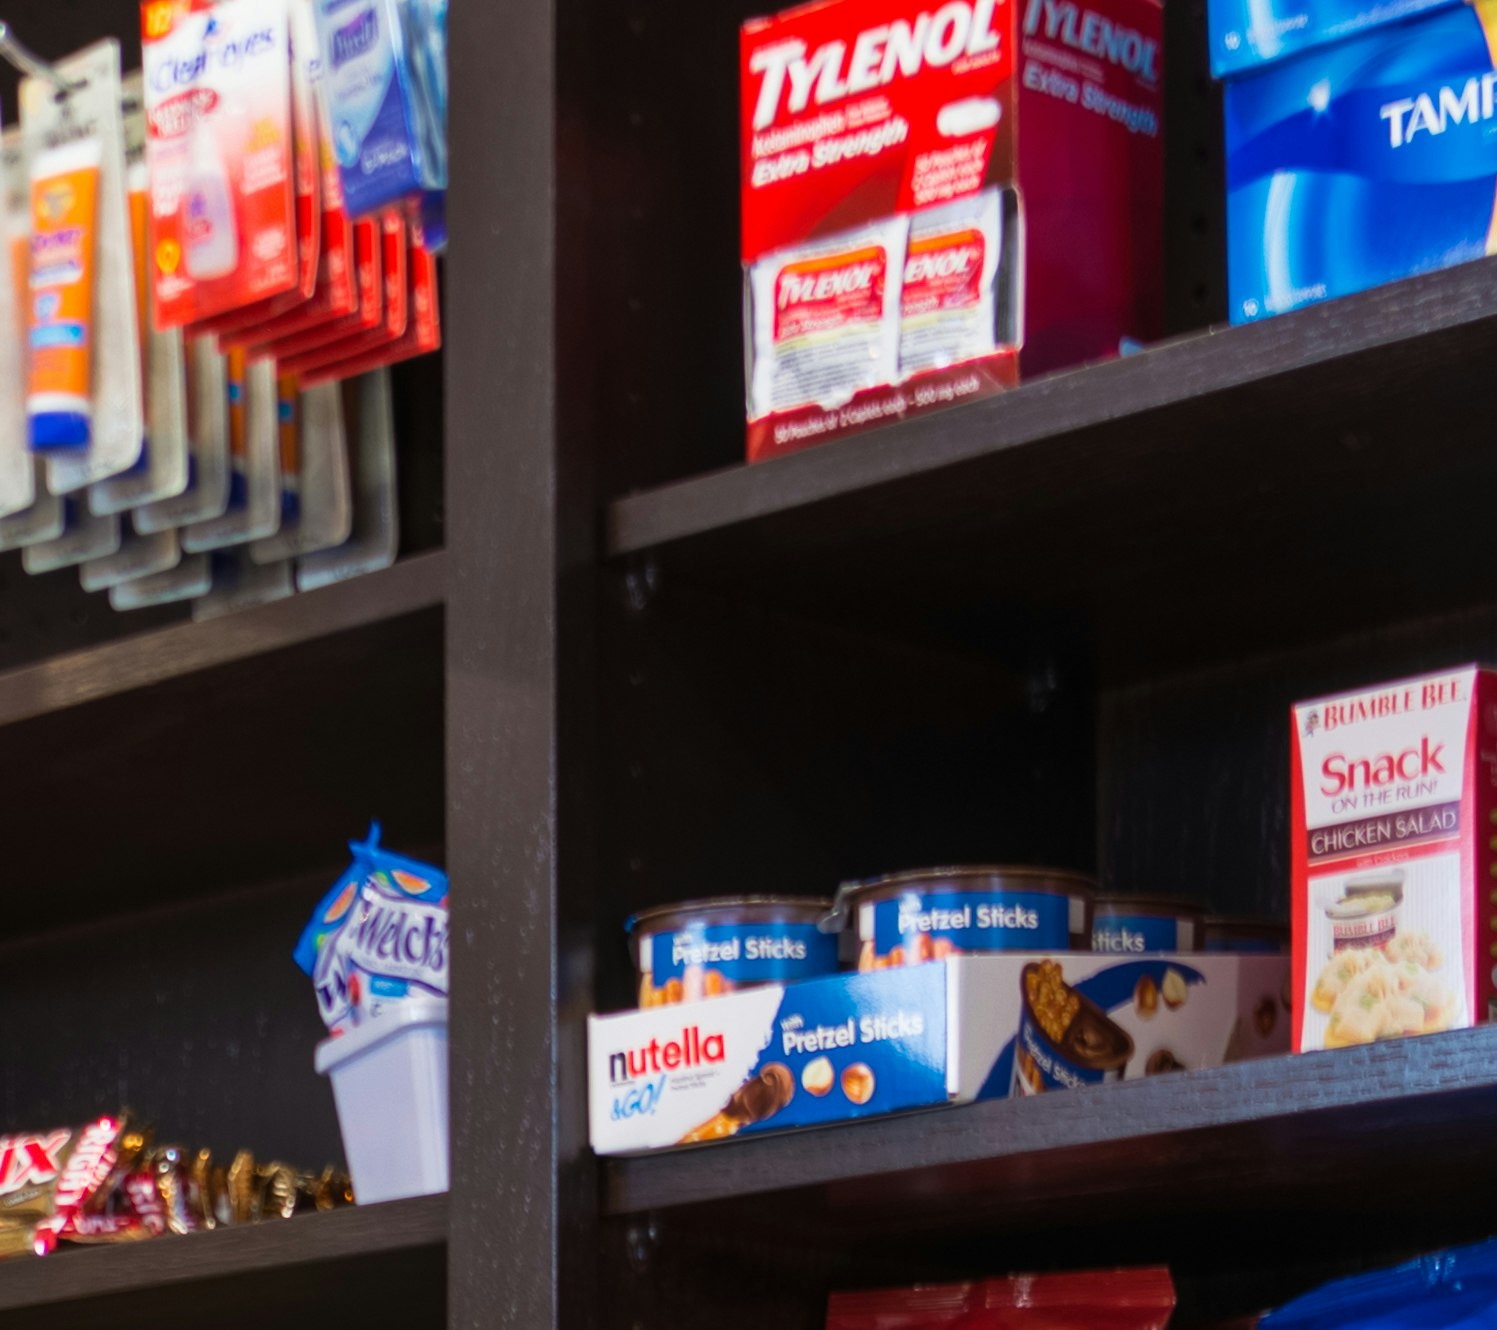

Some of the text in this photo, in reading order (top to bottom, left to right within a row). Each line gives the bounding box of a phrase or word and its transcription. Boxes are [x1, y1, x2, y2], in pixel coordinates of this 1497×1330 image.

[751, 0, 1001, 130] TYLENOL
[1024, 0, 1158, 81] TYLENOL
[752, 151, 808, 189] Extra
[813, 116, 908, 171] Strength
[1324, 679, 1462, 731] BUMBLE BEE
[1320, 736, 1446, 797] Snack
[1311, 809, 1456, 855] CHICKEN SALAD
[899, 903, 1039, 934] Pretzel Sticks
[1093, 931, 1145, 952] ticks
[672, 936, 806, 967] Pretzel Sticks
[608, 1026, 725, 1083] nutella
[783, 1013, 923, 1057] Pretzel Sticks
